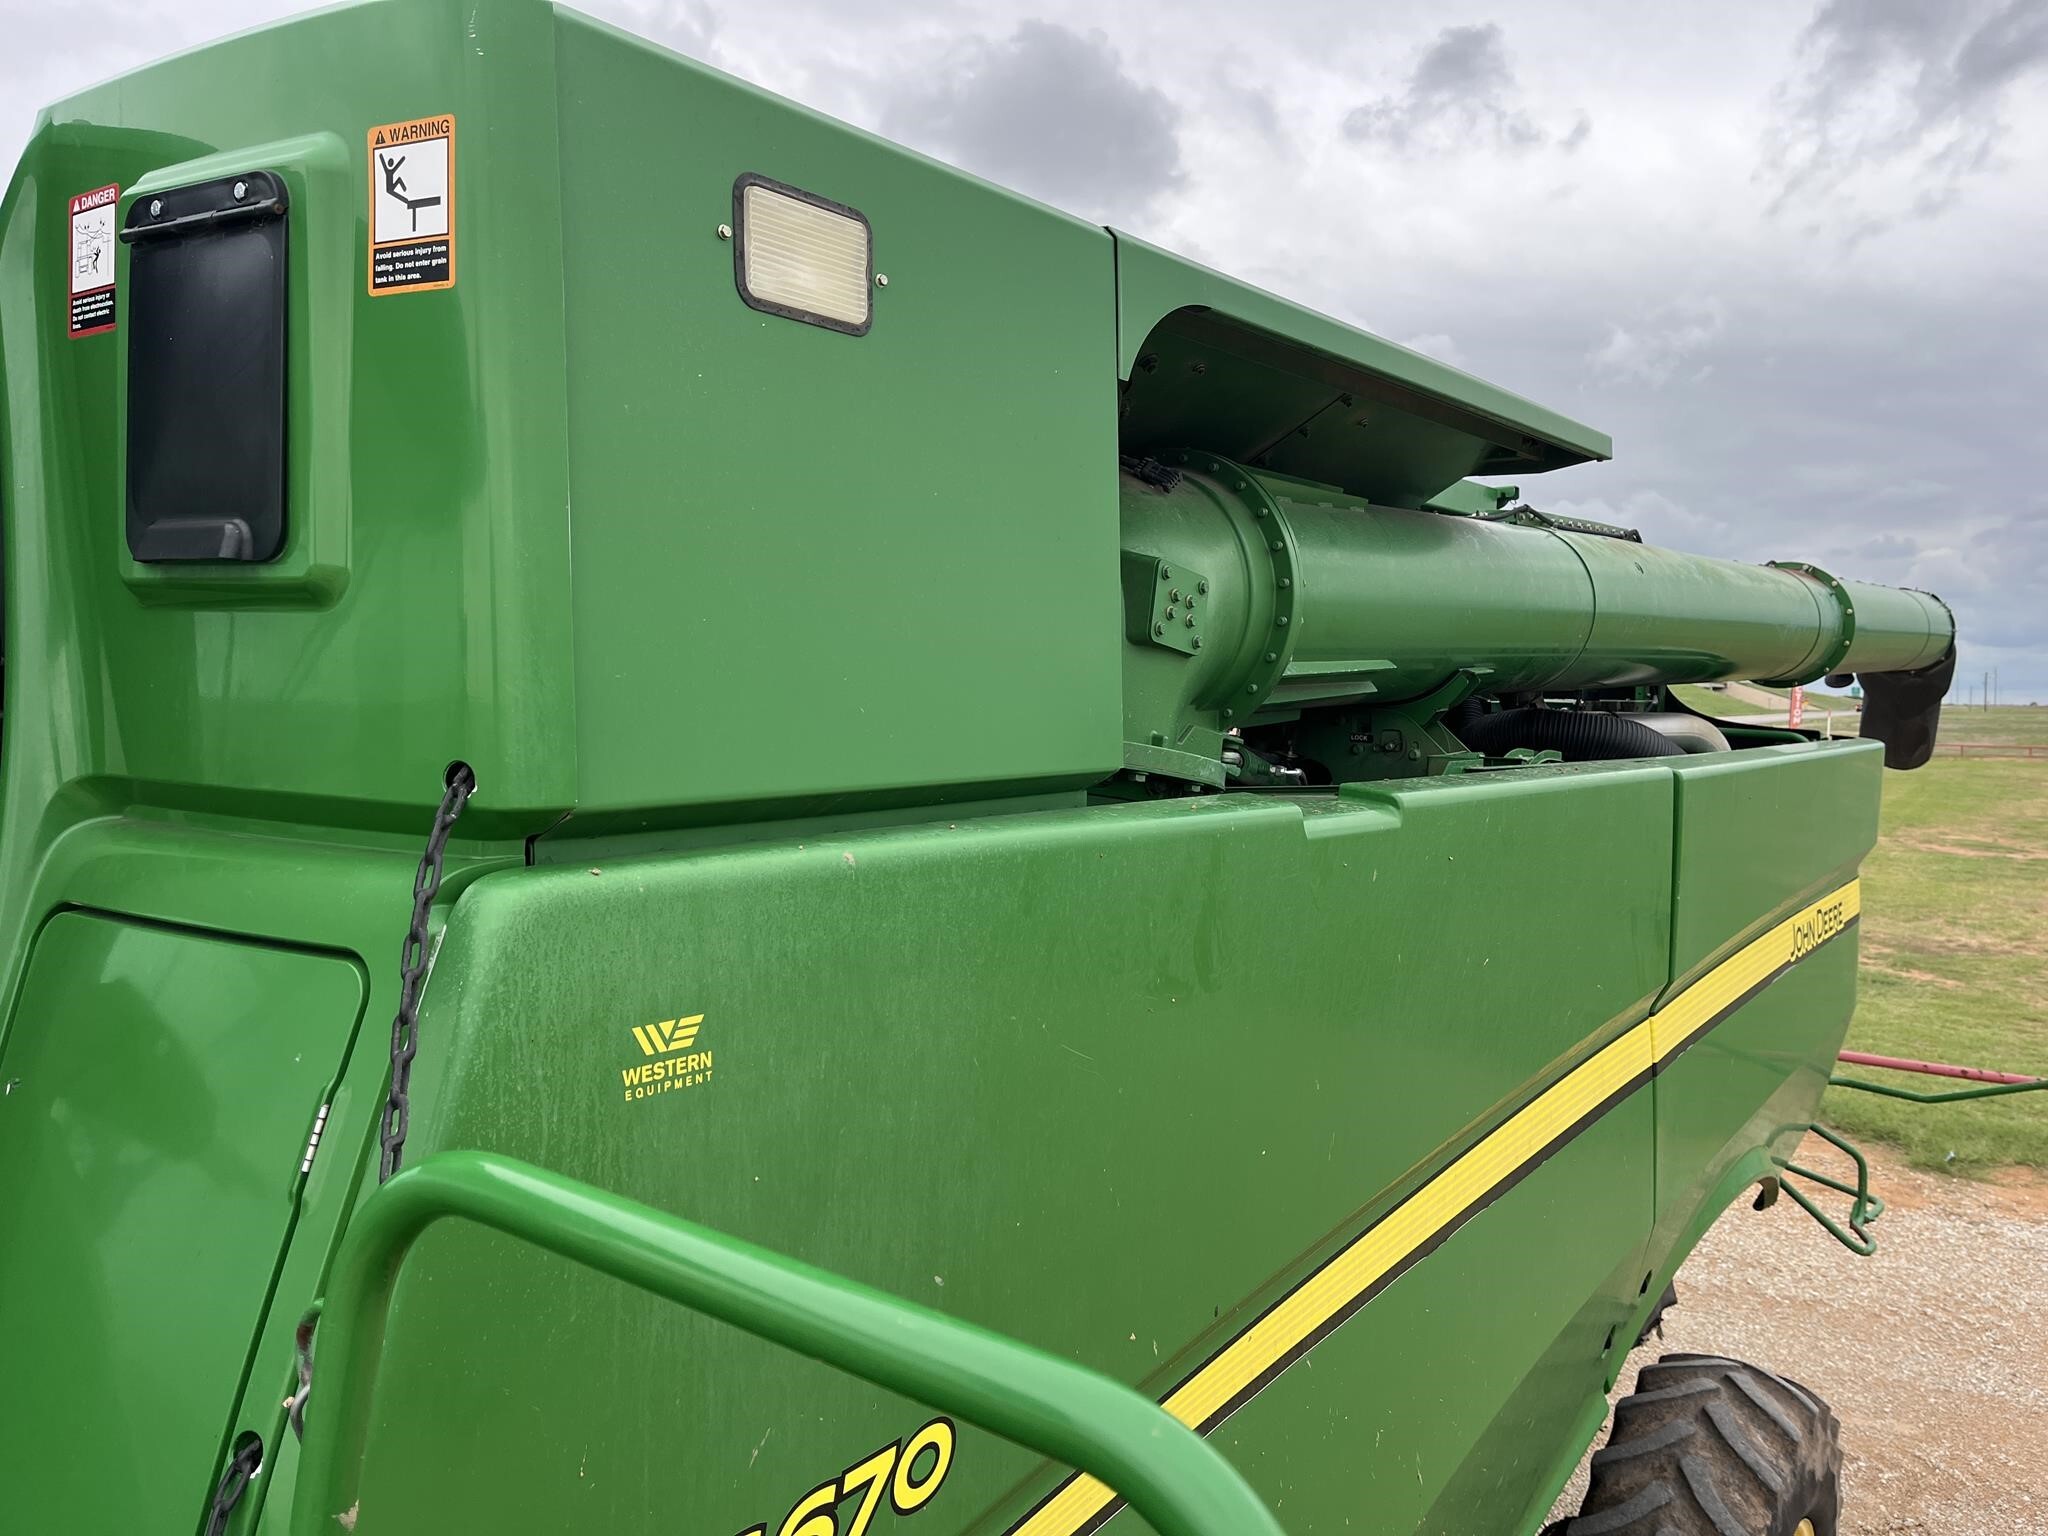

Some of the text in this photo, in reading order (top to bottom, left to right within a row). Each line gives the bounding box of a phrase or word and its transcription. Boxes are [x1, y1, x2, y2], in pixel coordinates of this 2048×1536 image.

[389, 119, 450, 142] WARNING
[81, 187, 116, 210] DANGER
[375, 245, 447, 260] Avoid serious injury from
[375, 264, 394, 272] falling.
[431, 257, 447, 266] grain
[395, 273, 406, 281] this
[1790, 903, 1844, 959] JOHN DEERE
[622, 1051, 712, 1087] WESTERN
[625, 1071, 712, 1102] EQUIPMENT
[733, 1415, 957, 1536] 670
